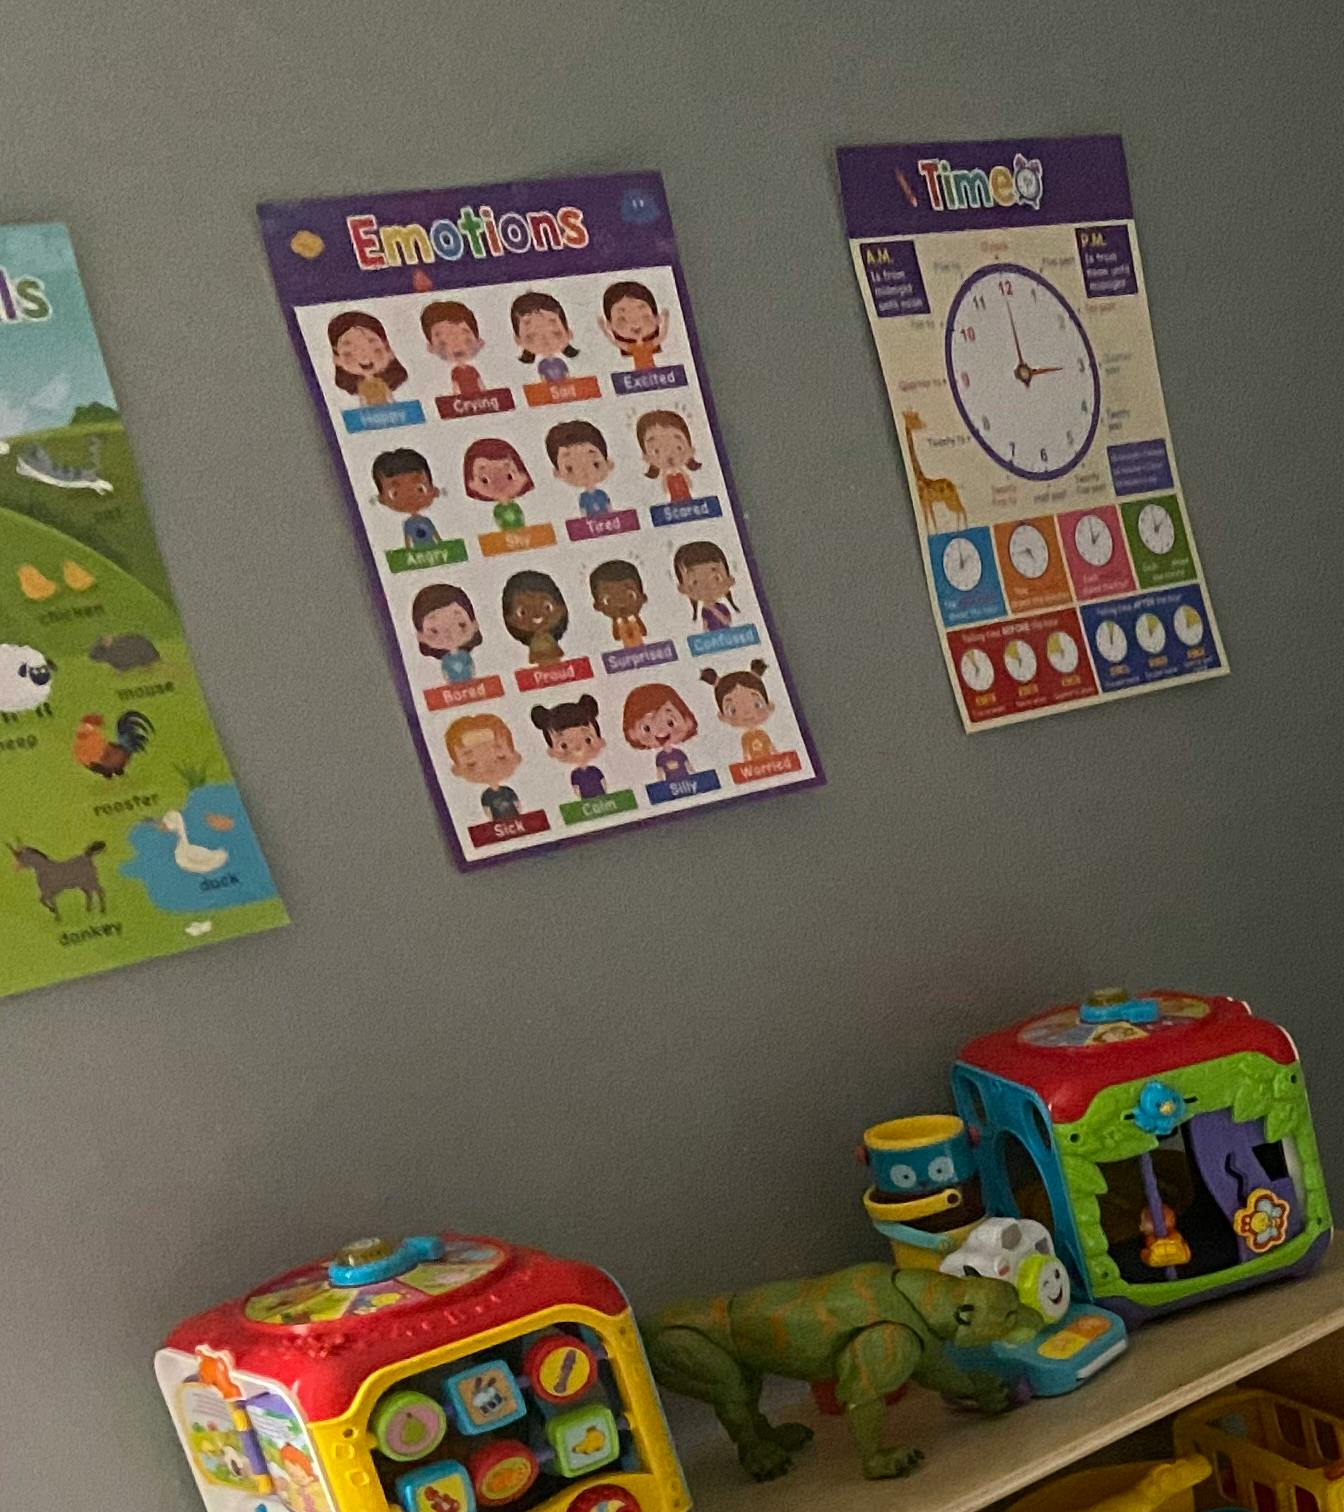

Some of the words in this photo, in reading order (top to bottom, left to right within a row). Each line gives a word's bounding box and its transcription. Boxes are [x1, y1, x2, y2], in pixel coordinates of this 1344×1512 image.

[917, 159, 1017, 211] Time
[346, 205, 590, 271] Emotions
[999, 279, 1013, 297] 12
[972, 295, 986, 310] 11
[960, 326, 977, 343] 10
[624, 370, 676, 390] Excited
[550, 384, 575, 399] Sad
[453, 396, 500, 415] Crying
[360, 408, 407, 427] Happy
[1040, 448, 1048, 462] 6
[663, 501, 709, 520] Scared
[586, 516, 621, 532] Tired
[407, 547, 449, 567] Angry
[692, 627, 755, 649] Confused
[607, 644, 673, 671] Surprised
[533, 665, 575, 683] Proud
[118, 680, 176, 702] mouse
[442, 685, 486, 703] Bored
[740, 757, 793, 778] Worried
[668, 779, 700, 798] Silly
[94, 792, 160, 818] rooster
[582, 798, 618, 816] Calm
[494, 818, 526, 837] Sick
[201, 873, 241, 892] duck
[59, 921, 123, 947] donkey
